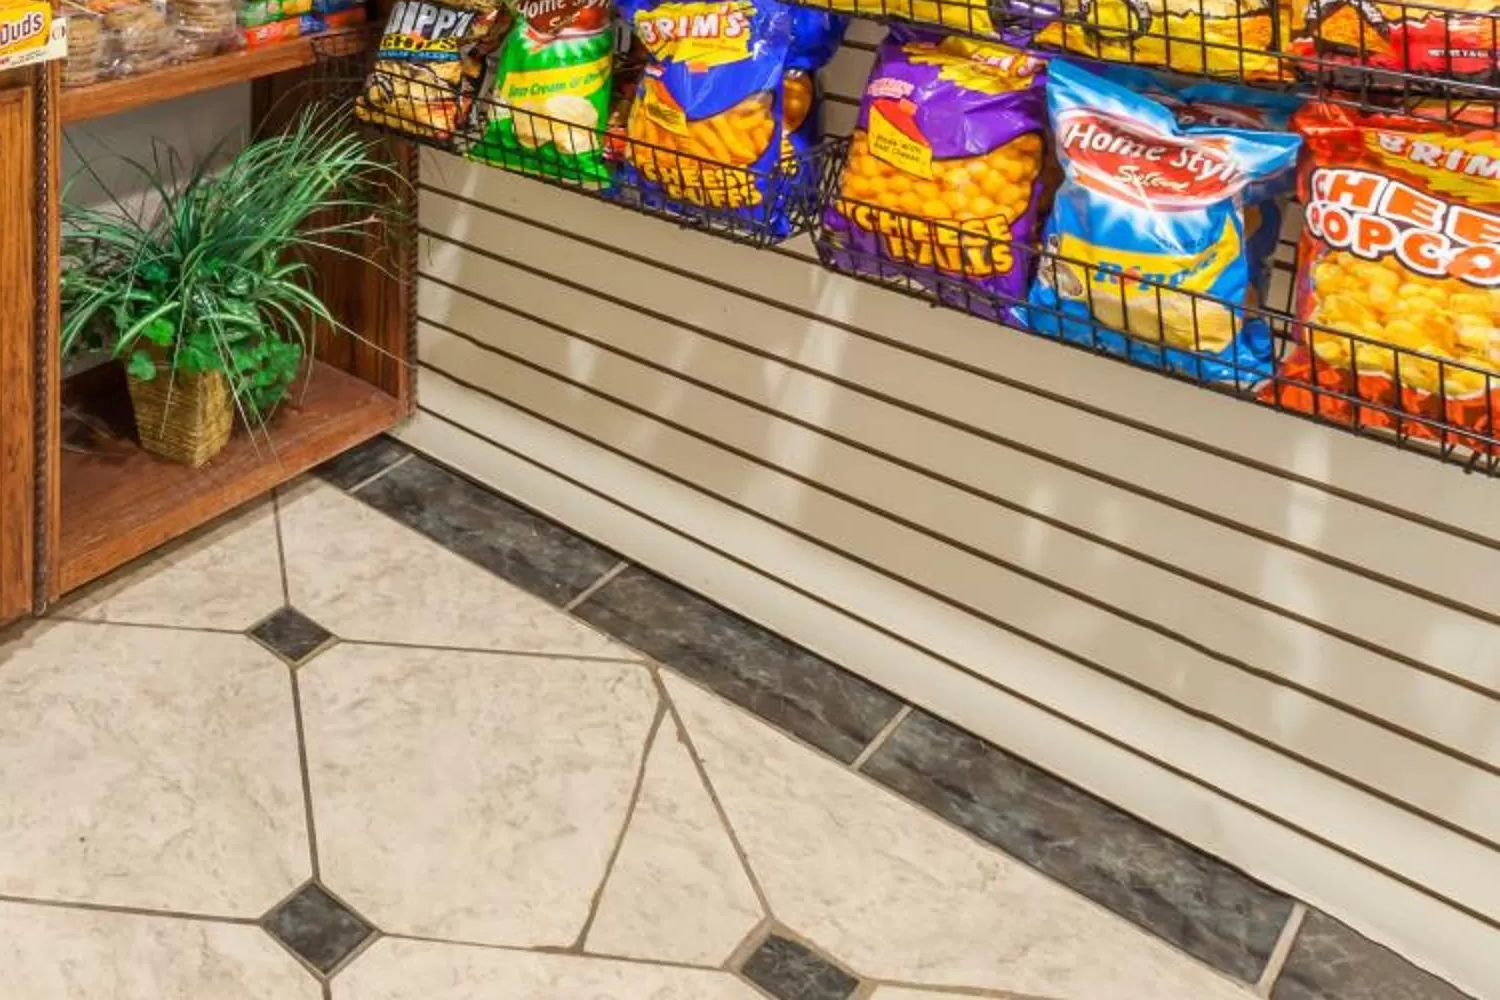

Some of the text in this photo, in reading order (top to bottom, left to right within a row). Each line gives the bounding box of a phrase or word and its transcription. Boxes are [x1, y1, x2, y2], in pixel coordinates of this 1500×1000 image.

[638, 4, 750, 45] BRIM'S
[1064, 122, 1168, 162] Home
[854, 206, 1012, 242] CHEESE
